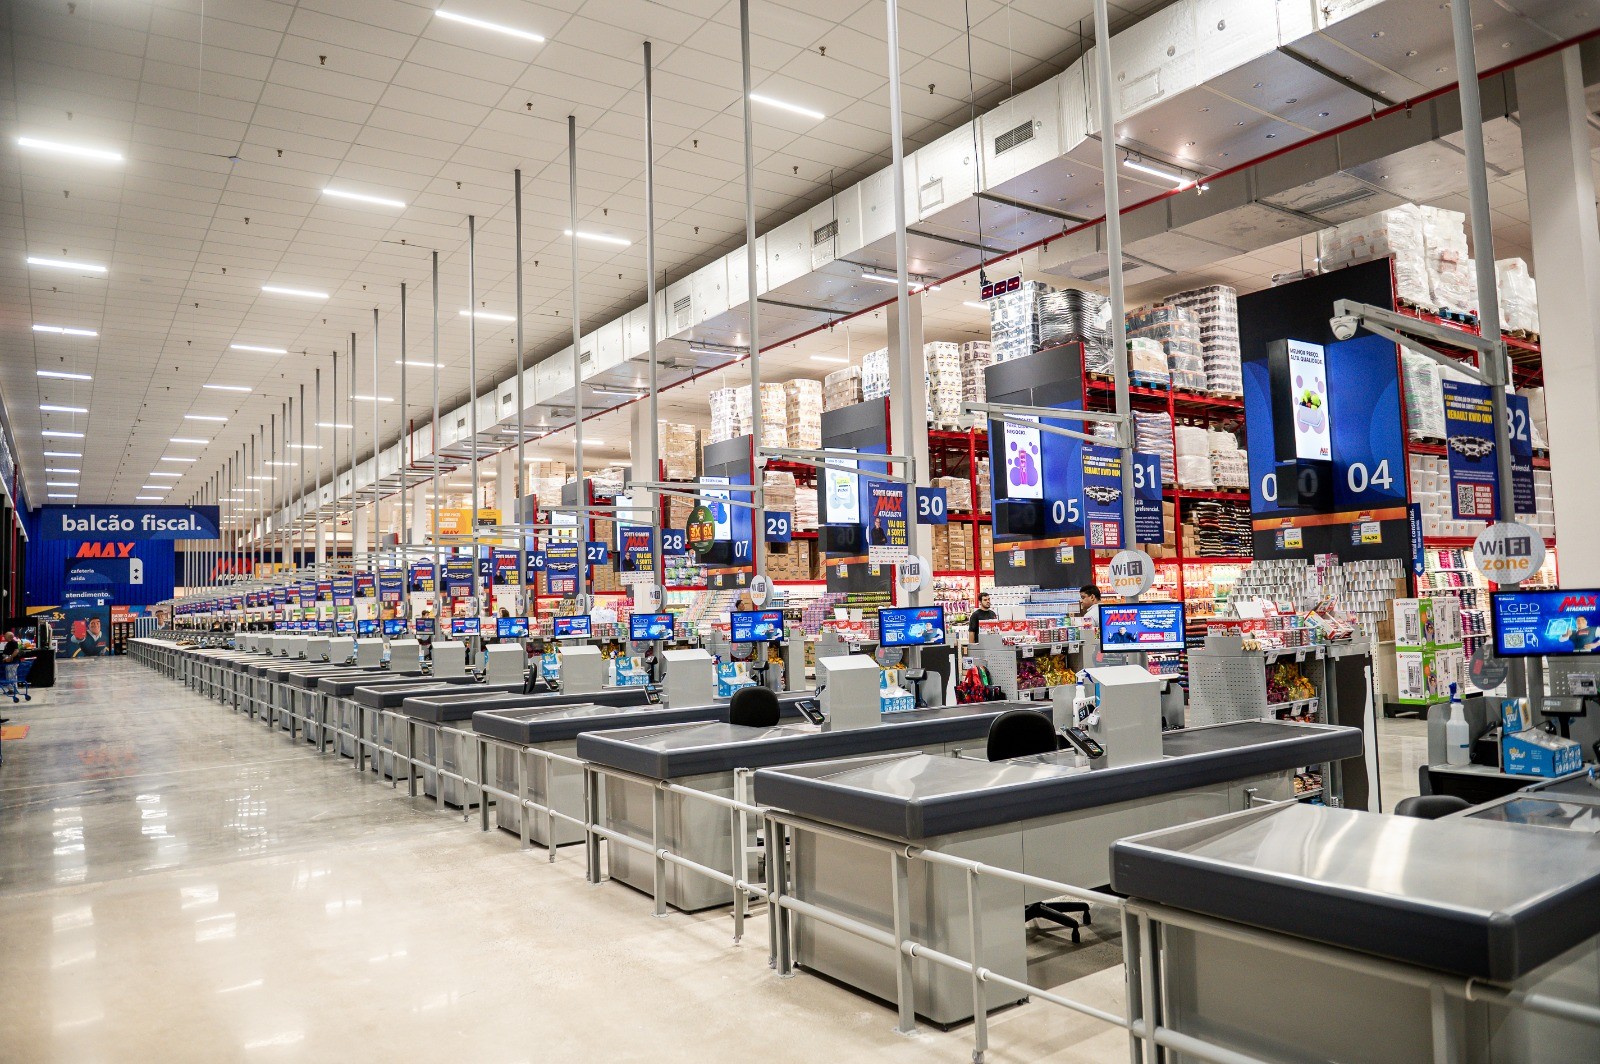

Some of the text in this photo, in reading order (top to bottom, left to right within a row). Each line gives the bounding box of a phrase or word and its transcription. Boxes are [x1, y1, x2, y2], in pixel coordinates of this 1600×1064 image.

[1447, 410, 1468, 420] RENAULT
[1134, 464, 1156, 489] 31
[1348, 460, 1393, 492] 04
[874, 496, 903, 516] MAX
[919, 496, 944, 516] 30
[1052, 498, 1079, 524] 05
[62, 514, 202, 532] balcão fiscal.
[766, 518, 788, 535] 29
[690, 528, 700, 537] 3X
[76, 542, 135, 558] MAX
[625, 537, 649, 552] MAX
[663, 534, 682, 550] 28
[735, 540, 748, 558] 07
[1480, 537, 1531, 556] WiFi
[528, 556, 544, 566] 26
[588, 546, 604, 560] 27
[900, 564, 920, 576] WiFi
[1112, 560, 1143, 576] WiFi
[1483, 558, 1529, 570] zone
[902, 576, 920, 584] zone
[1114, 575, 1142, 587] zone
[1500, 602, 1540, 612] LGPD
[1558, 595, 1598, 612] MAX
[1106, 613, 1137, 626] MAX
